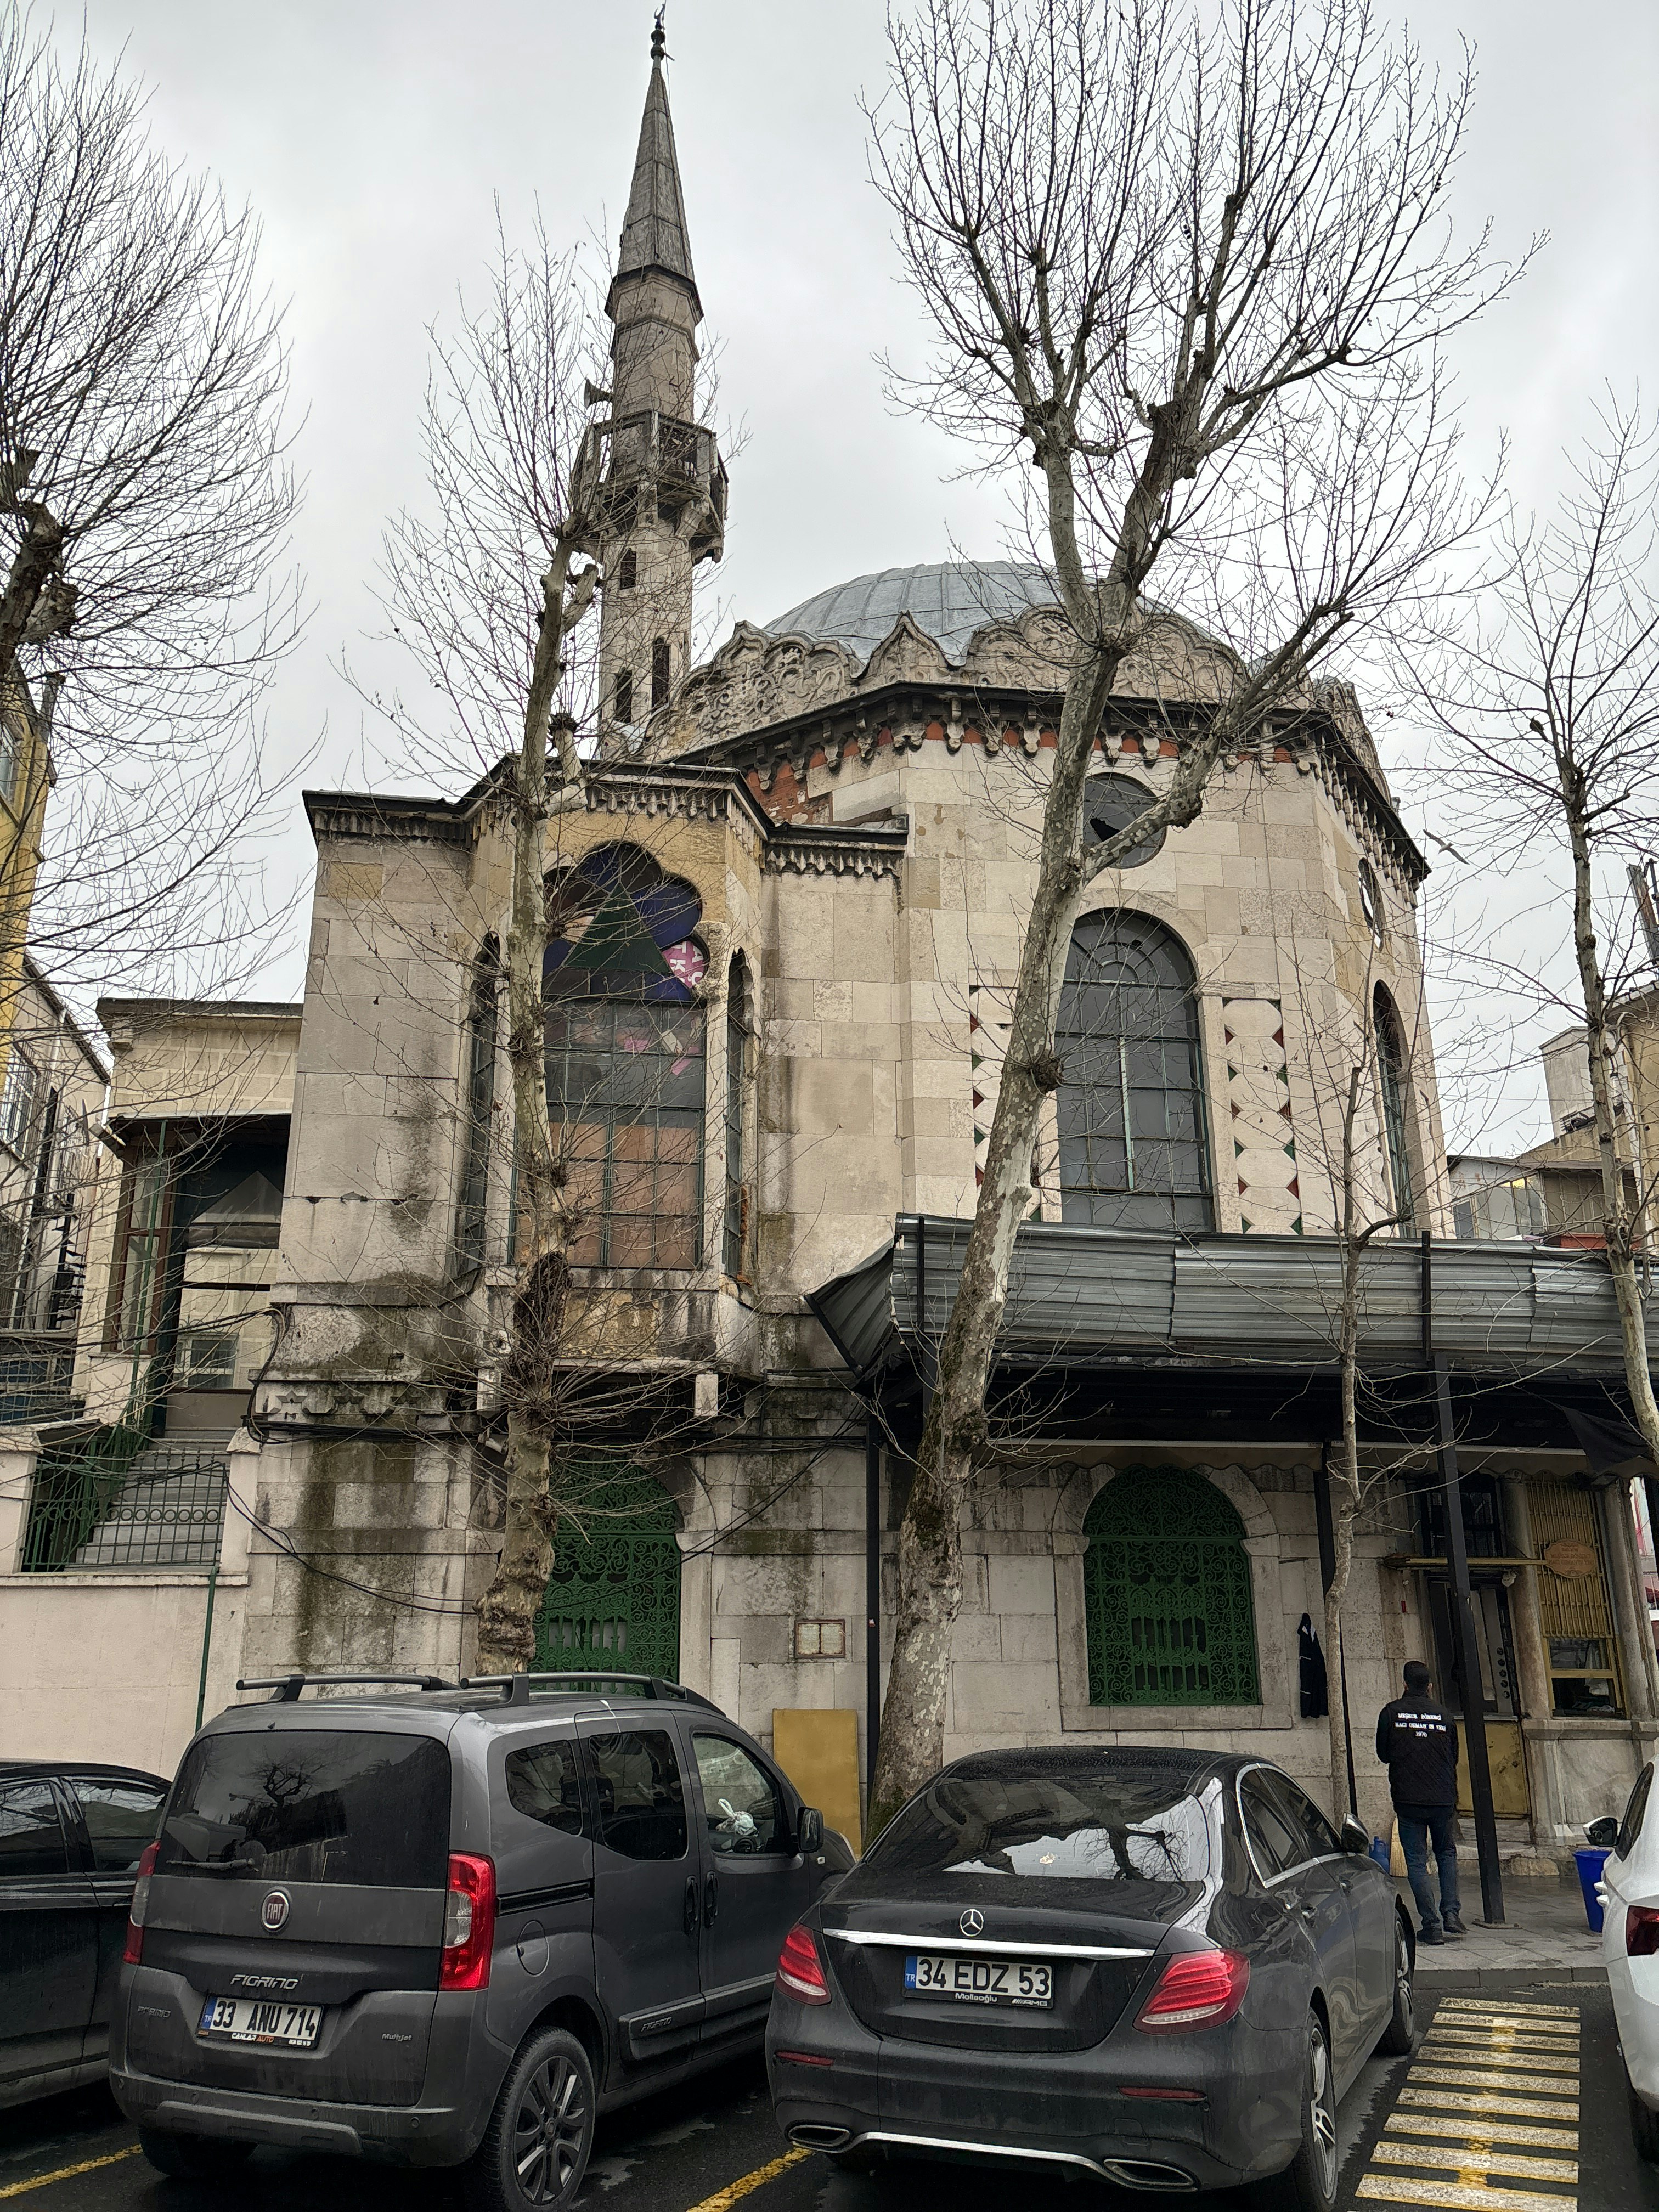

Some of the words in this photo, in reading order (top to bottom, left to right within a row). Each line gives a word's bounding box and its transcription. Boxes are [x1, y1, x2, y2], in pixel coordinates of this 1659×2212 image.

[267, 1903, 283, 1920] FIAT
[230, 1974, 298, 1990] FIORINO
[906, 1973, 916, 1982] TR
[918, 1959, 946, 1988] 34
[954, 1960, 1009, 1993] EDZ
[1019, 1966, 1050, 1996] 53
[955, 1992, 998, 2003] Mollaoğlu
[205, 2015, 212, 2023] TR
[213, 2001, 236, 2028] 33
[247, 2004, 283, 2033] ANU
[284, 2007, 315, 2038] 714
[256, 2034, 274, 2043] AUTO
